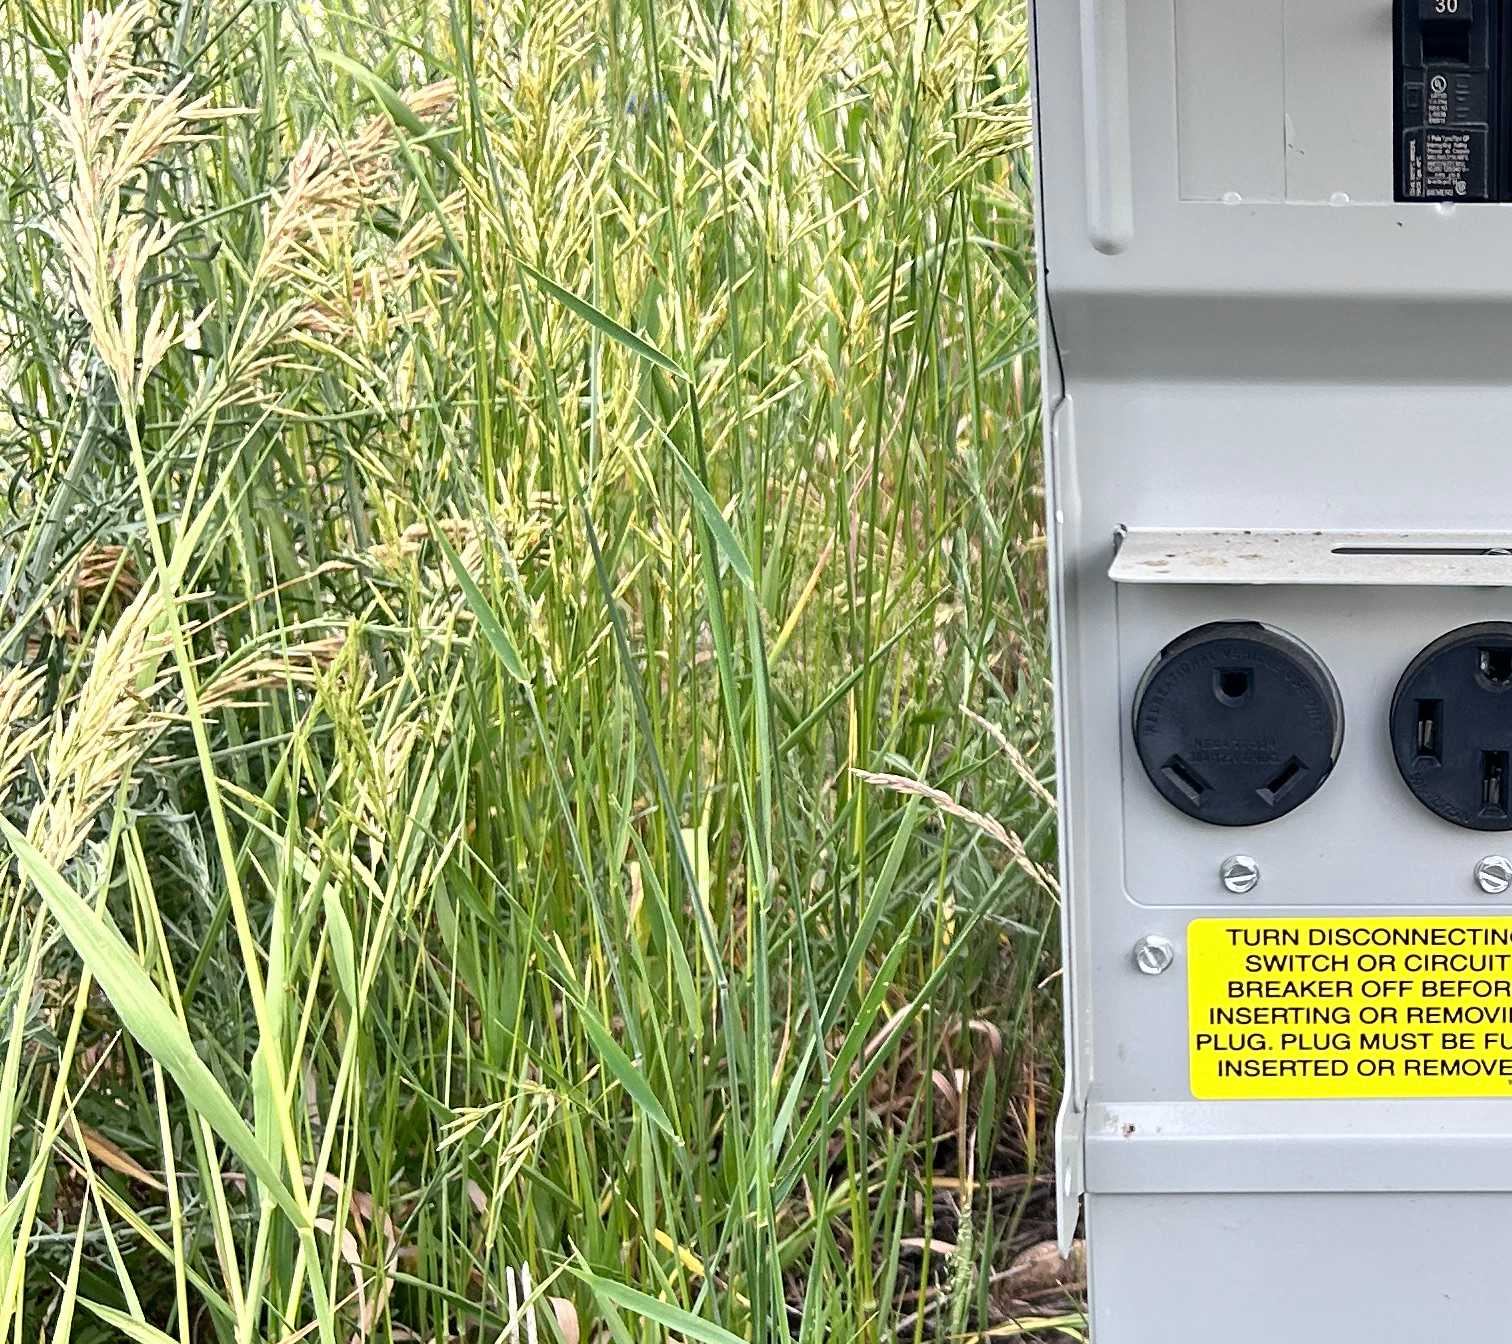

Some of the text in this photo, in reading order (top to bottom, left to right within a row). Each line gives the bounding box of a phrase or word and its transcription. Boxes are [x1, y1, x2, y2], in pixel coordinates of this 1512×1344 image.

[1225, 928, 1299, 947] TURN
[1245, 953, 1512, 973] SWITCH OR CIRCUIT
[1228, 980, 1353, 998] BREAKER
[1361, 979, 1414, 998] OFF
[1209, 1006, 1351, 1025] INSERTING
[1359, 1006, 1398, 1025] OR
[1196, 1033, 1273, 1051] PLUG.
[1281, 1032, 1351, 1051] PLUG
[1360, 1032, 1434, 1051] MUST
[1441, 1032, 1475, 1050] BE
[1218, 1059, 1349, 1077] INSERTED
[1356, 1059, 1395, 1077] OR
